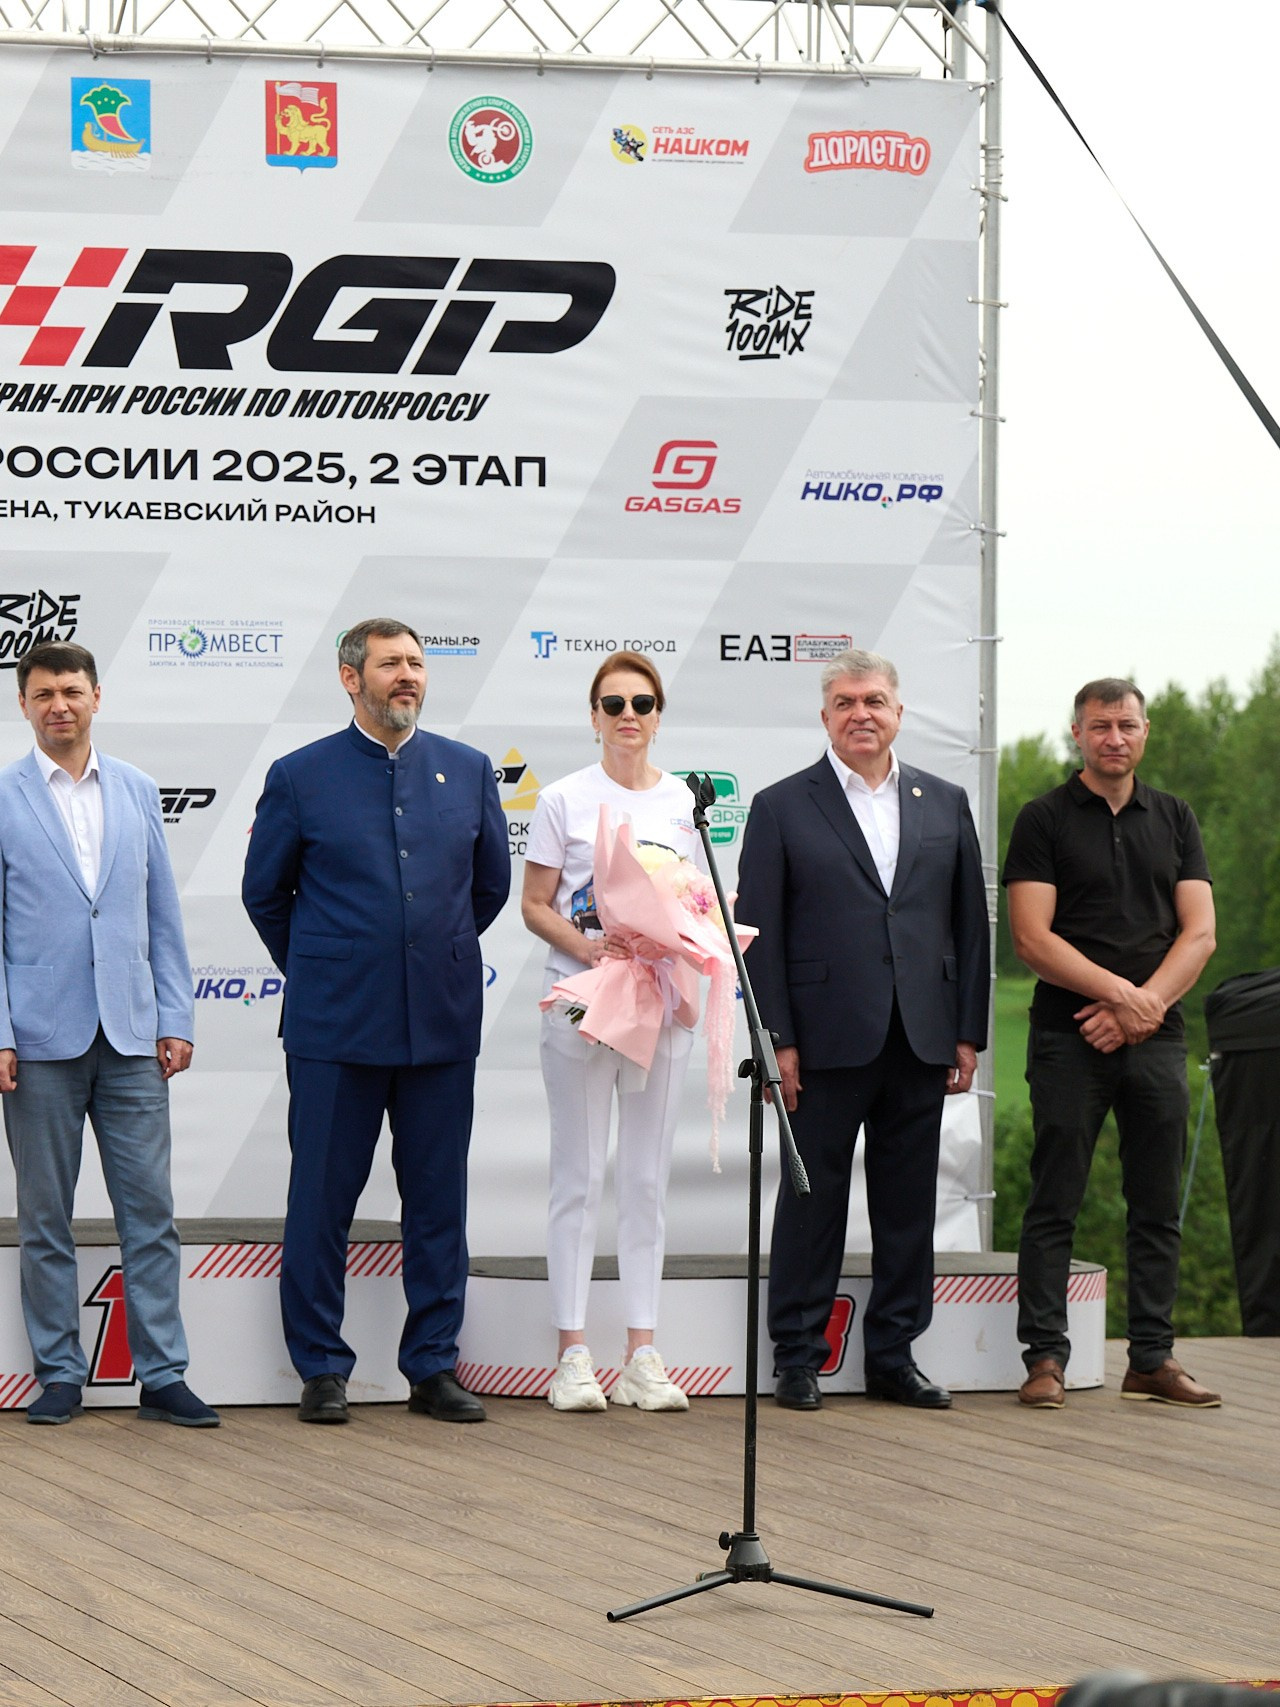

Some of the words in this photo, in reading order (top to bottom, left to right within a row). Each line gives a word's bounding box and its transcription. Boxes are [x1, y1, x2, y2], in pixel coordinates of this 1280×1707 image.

[651, 124, 675, 136] СЕТЬ
[676, 126, 695, 136] АЗС
[81, 248, 617, 376] RGP
[121, 384, 242, 416] РОССИИ
[243, 387, 289, 418] ПО
[288, 388, 490, 422] МОТОКРОССУ
[212, 449, 358, 490] 2025,
[369, 452, 400, 485] 2
[412, 453, 546, 488] ЭТАП
[805, 470, 890, 481] Автомобильная
[893, 474, 944, 482] компания
[64, 498, 267, 522] ТУКАЕВСКИЙ
[275, 499, 376, 524] РАЙОН
[624, 497, 741, 514] GASGAS
[420, 636, 480, 646] РАНЫ.РФ
[564, 640, 618, 653] ТЕХНО
[623, 640, 677, 653] ГОРОД
